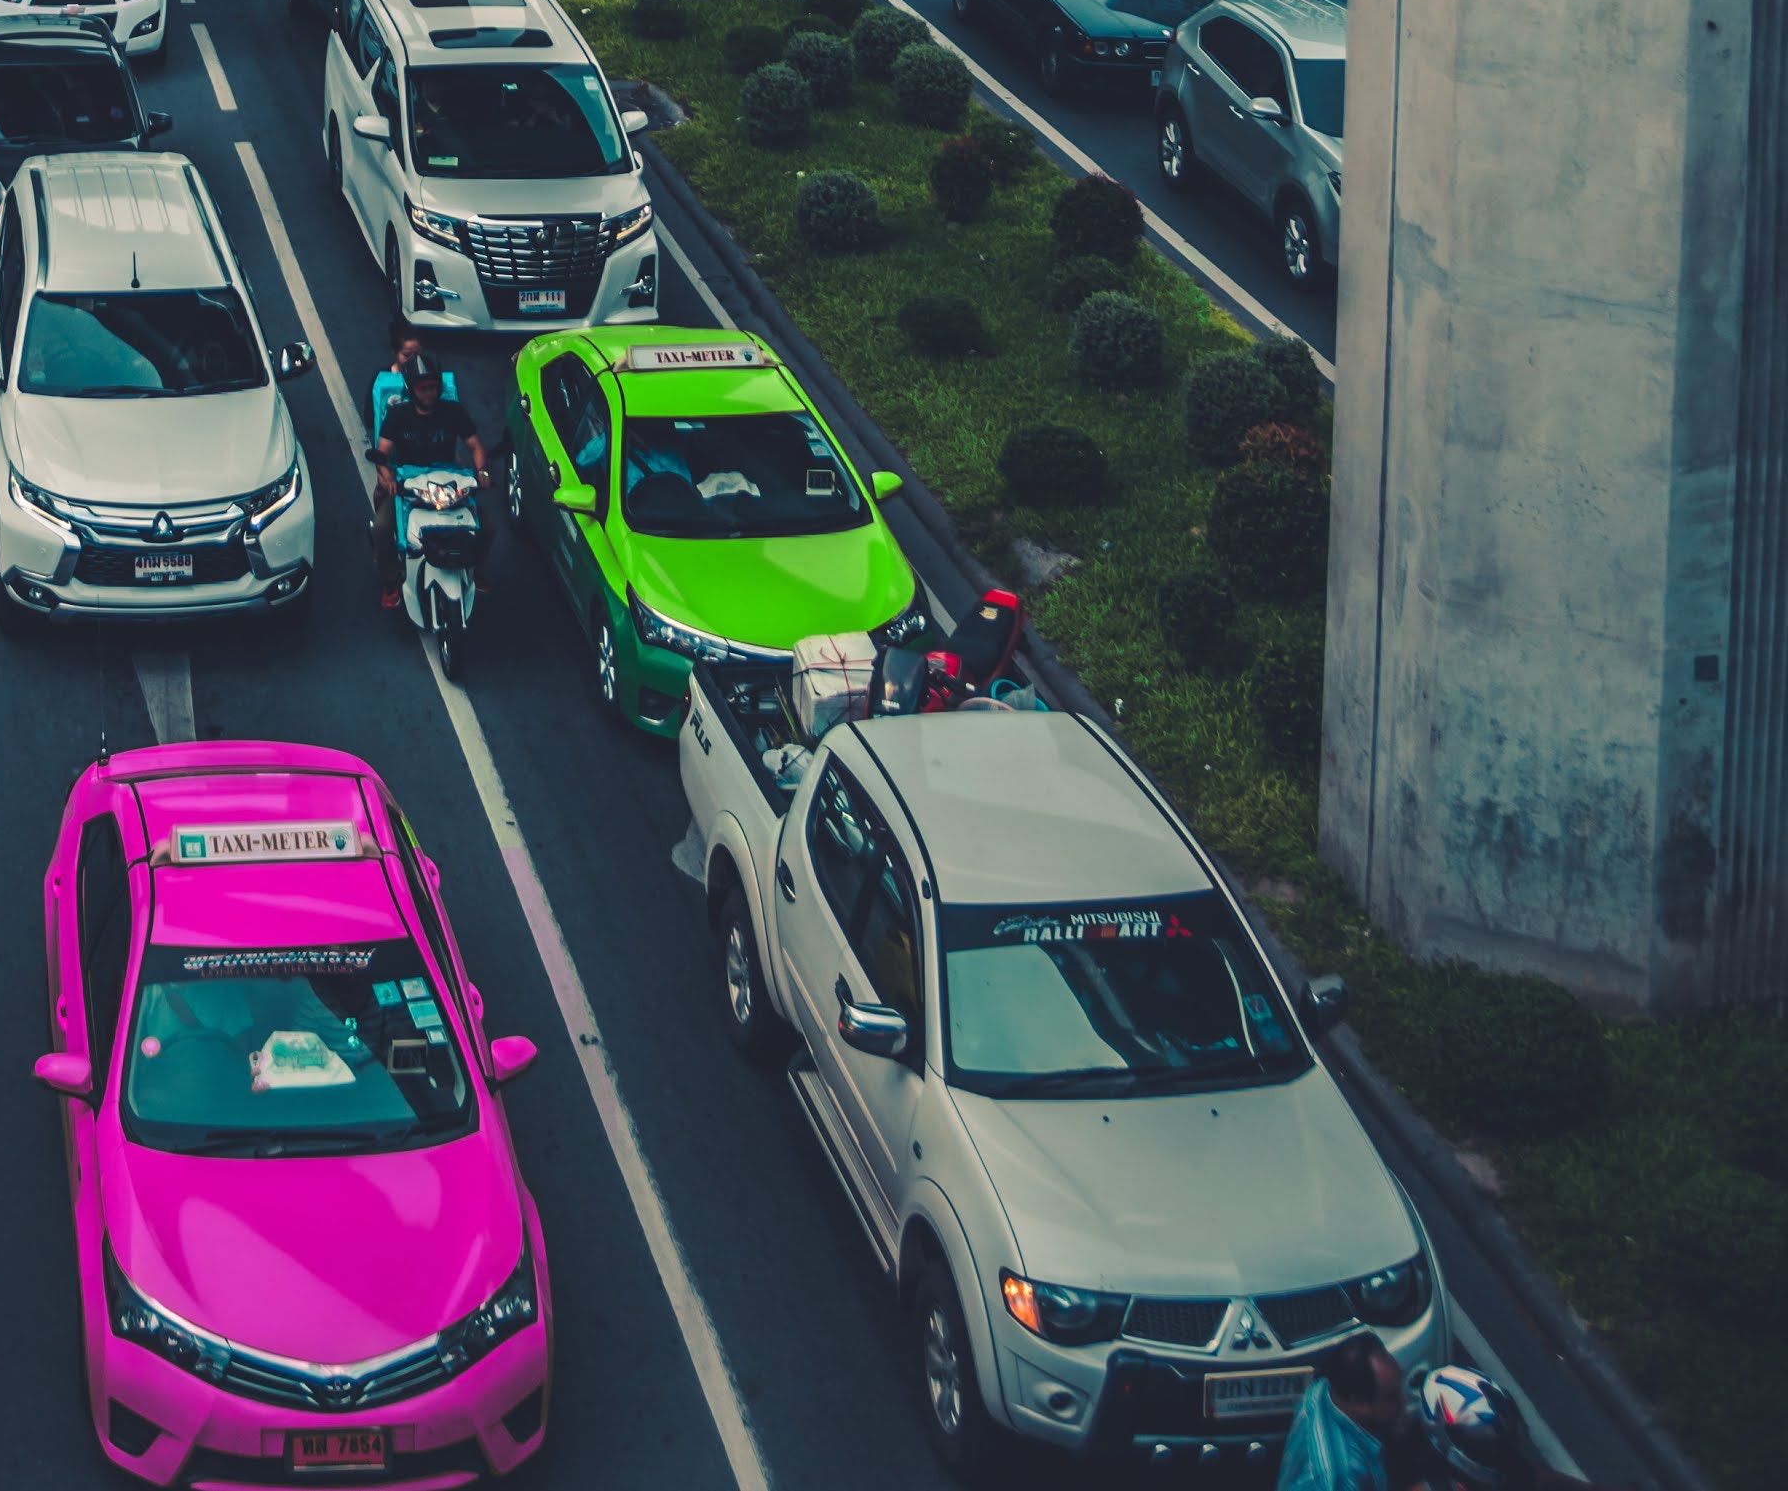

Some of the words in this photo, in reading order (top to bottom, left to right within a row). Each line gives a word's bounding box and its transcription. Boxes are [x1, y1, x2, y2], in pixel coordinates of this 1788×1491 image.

[654, 350, 735, 363] TAXI-METER
[209, 830, 330, 854] TAXI-METER
[1070, 911, 1162, 925] MITSUBISHI
[1024, 925, 1085, 941] RALLI
[1119, 922, 1162, 937] ART
